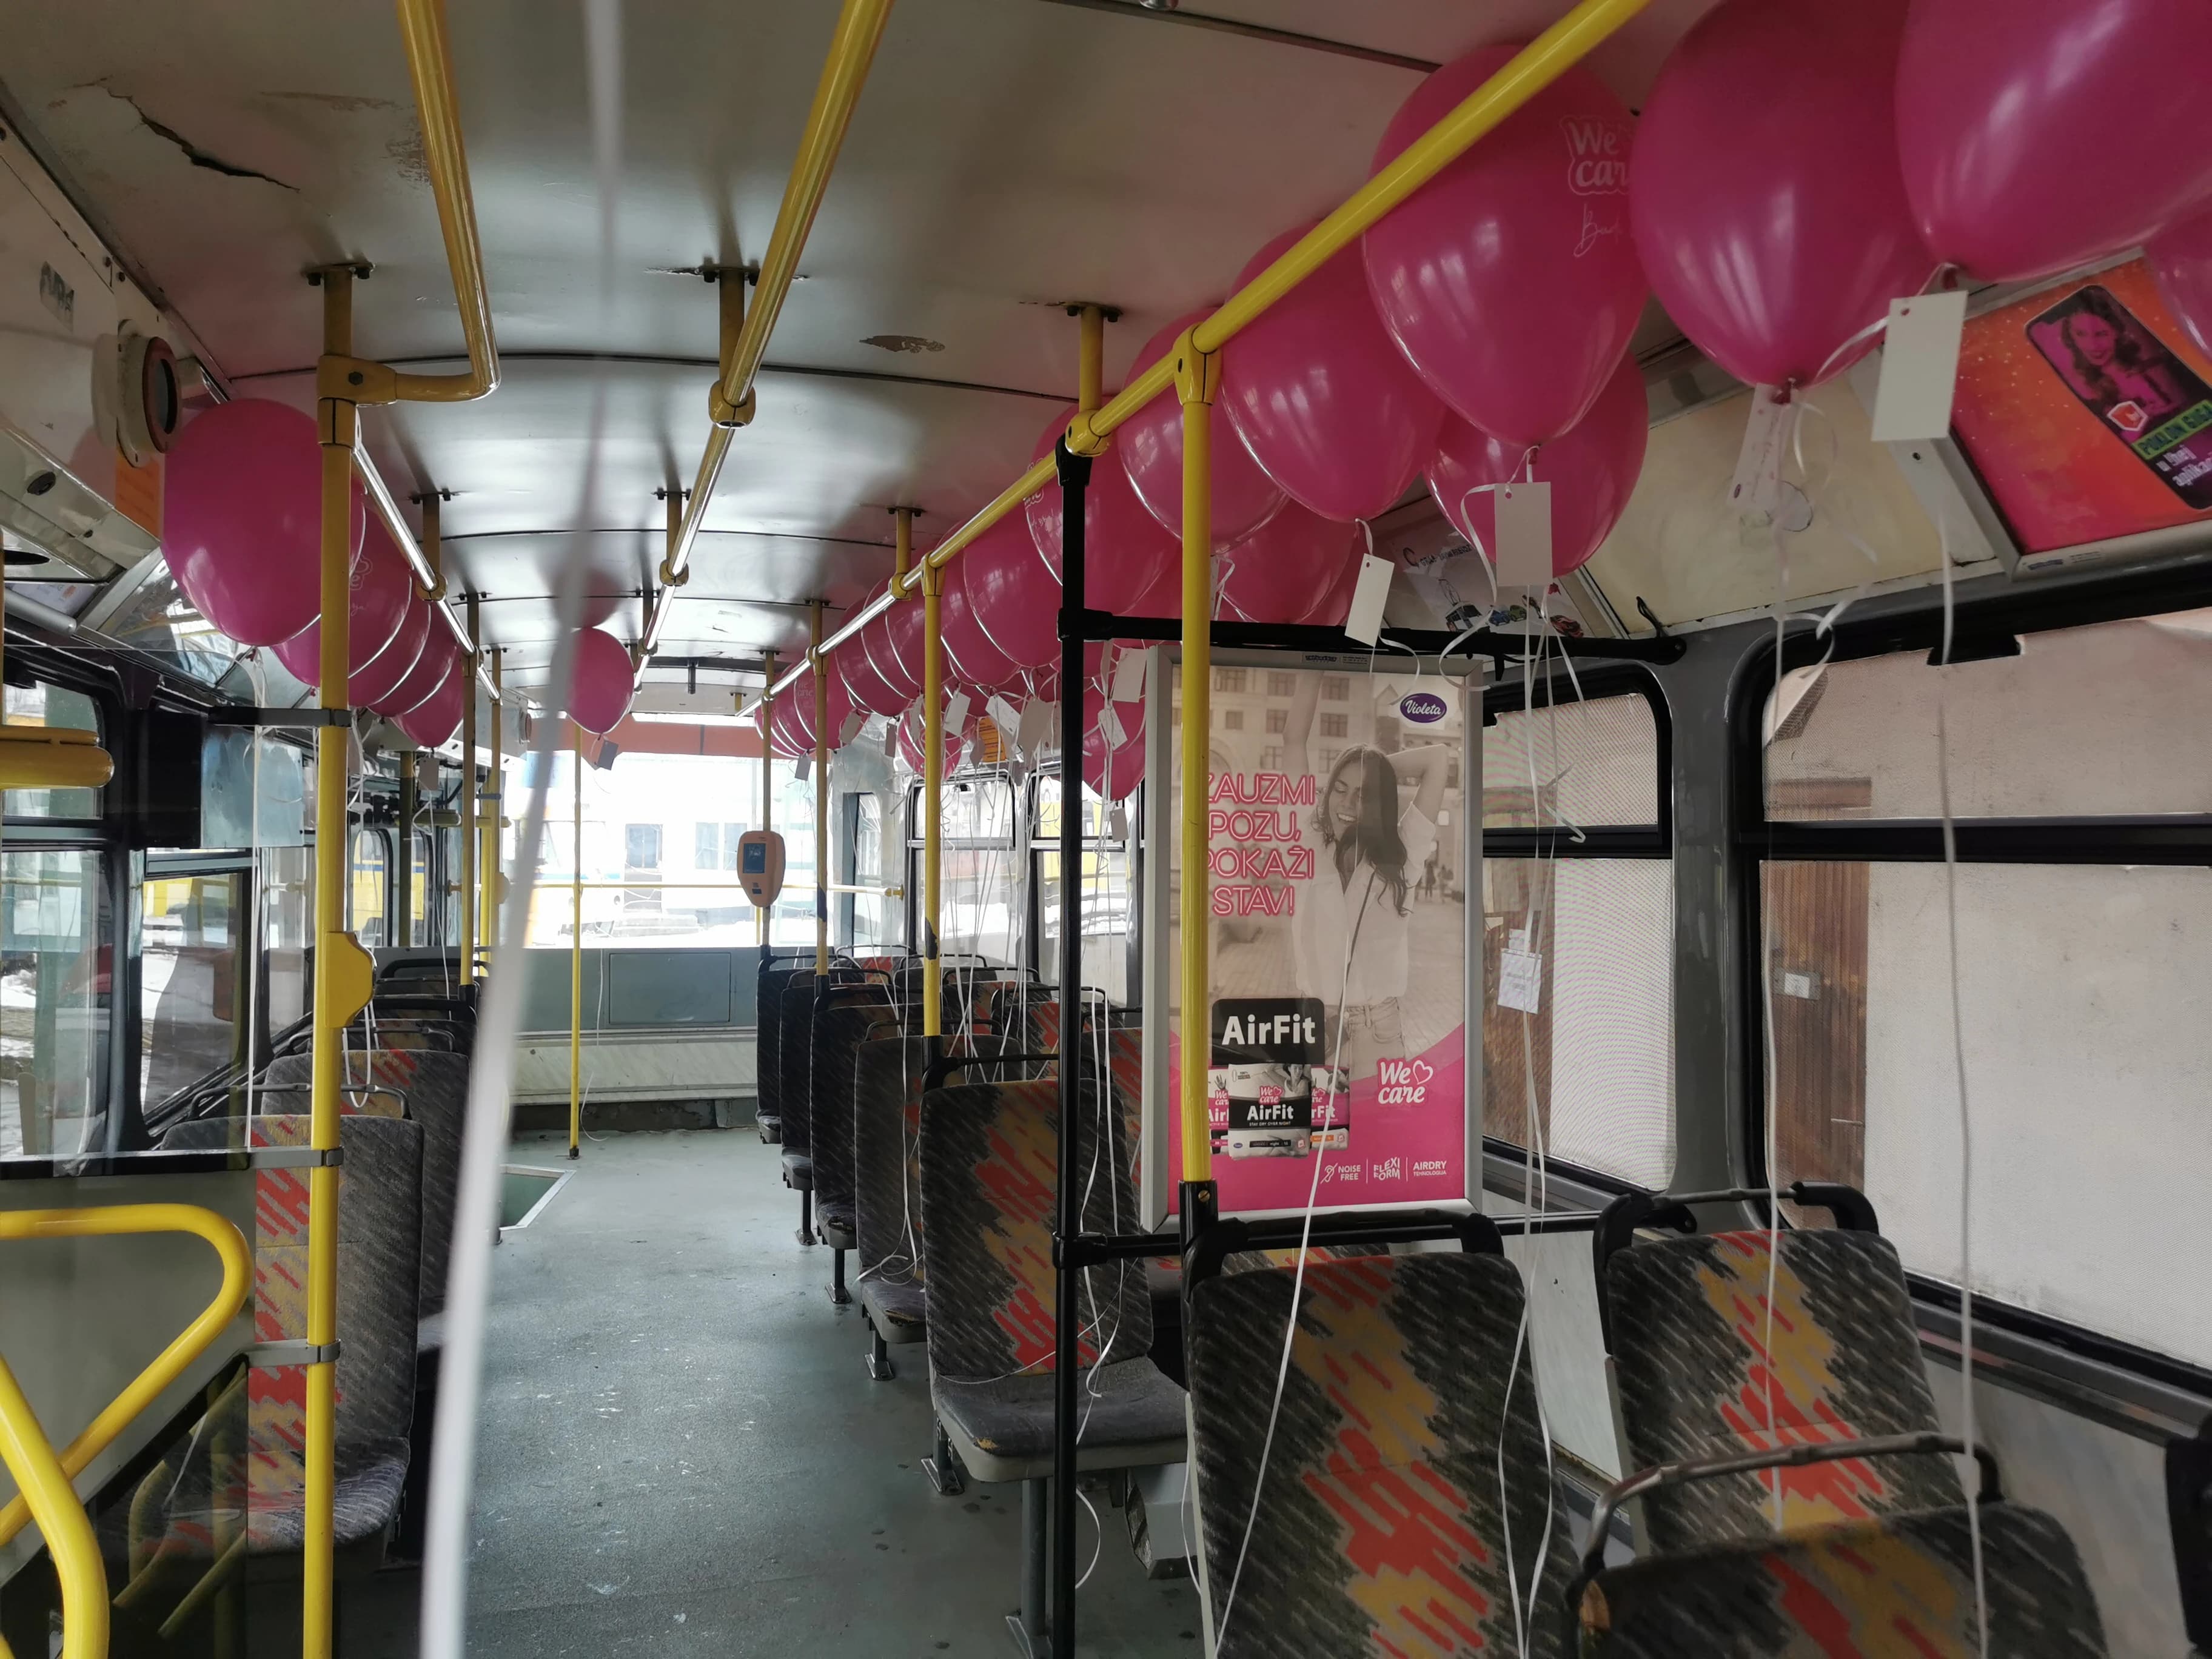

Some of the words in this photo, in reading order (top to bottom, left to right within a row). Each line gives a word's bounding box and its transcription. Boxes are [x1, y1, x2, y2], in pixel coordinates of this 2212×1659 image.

[1567, 121, 1620, 155] We
[1575, 159, 1629, 187] car
[1405, 700, 1441, 715] Violeta
[1208, 810, 1302, 842] POZU,
[1212, 885, 1295, 917] STAV!
[1221, 1013, 1316, 1045] AirFit
[1380, 1061, 1411, 1085] We
[1261, 1087, 1273, 1096] We
[1378, 1085, 1426, 1104] care
[1247, 1104, 1294, 1121] AirFit
[1338, 1165, 1361, 1173] NOISE
[1373, 1157, 1400, 1171] FLEXI
[1413, 1161, 1447, 1171] AIRDRY
[1373, 1168, 1400, 1181] FORM
